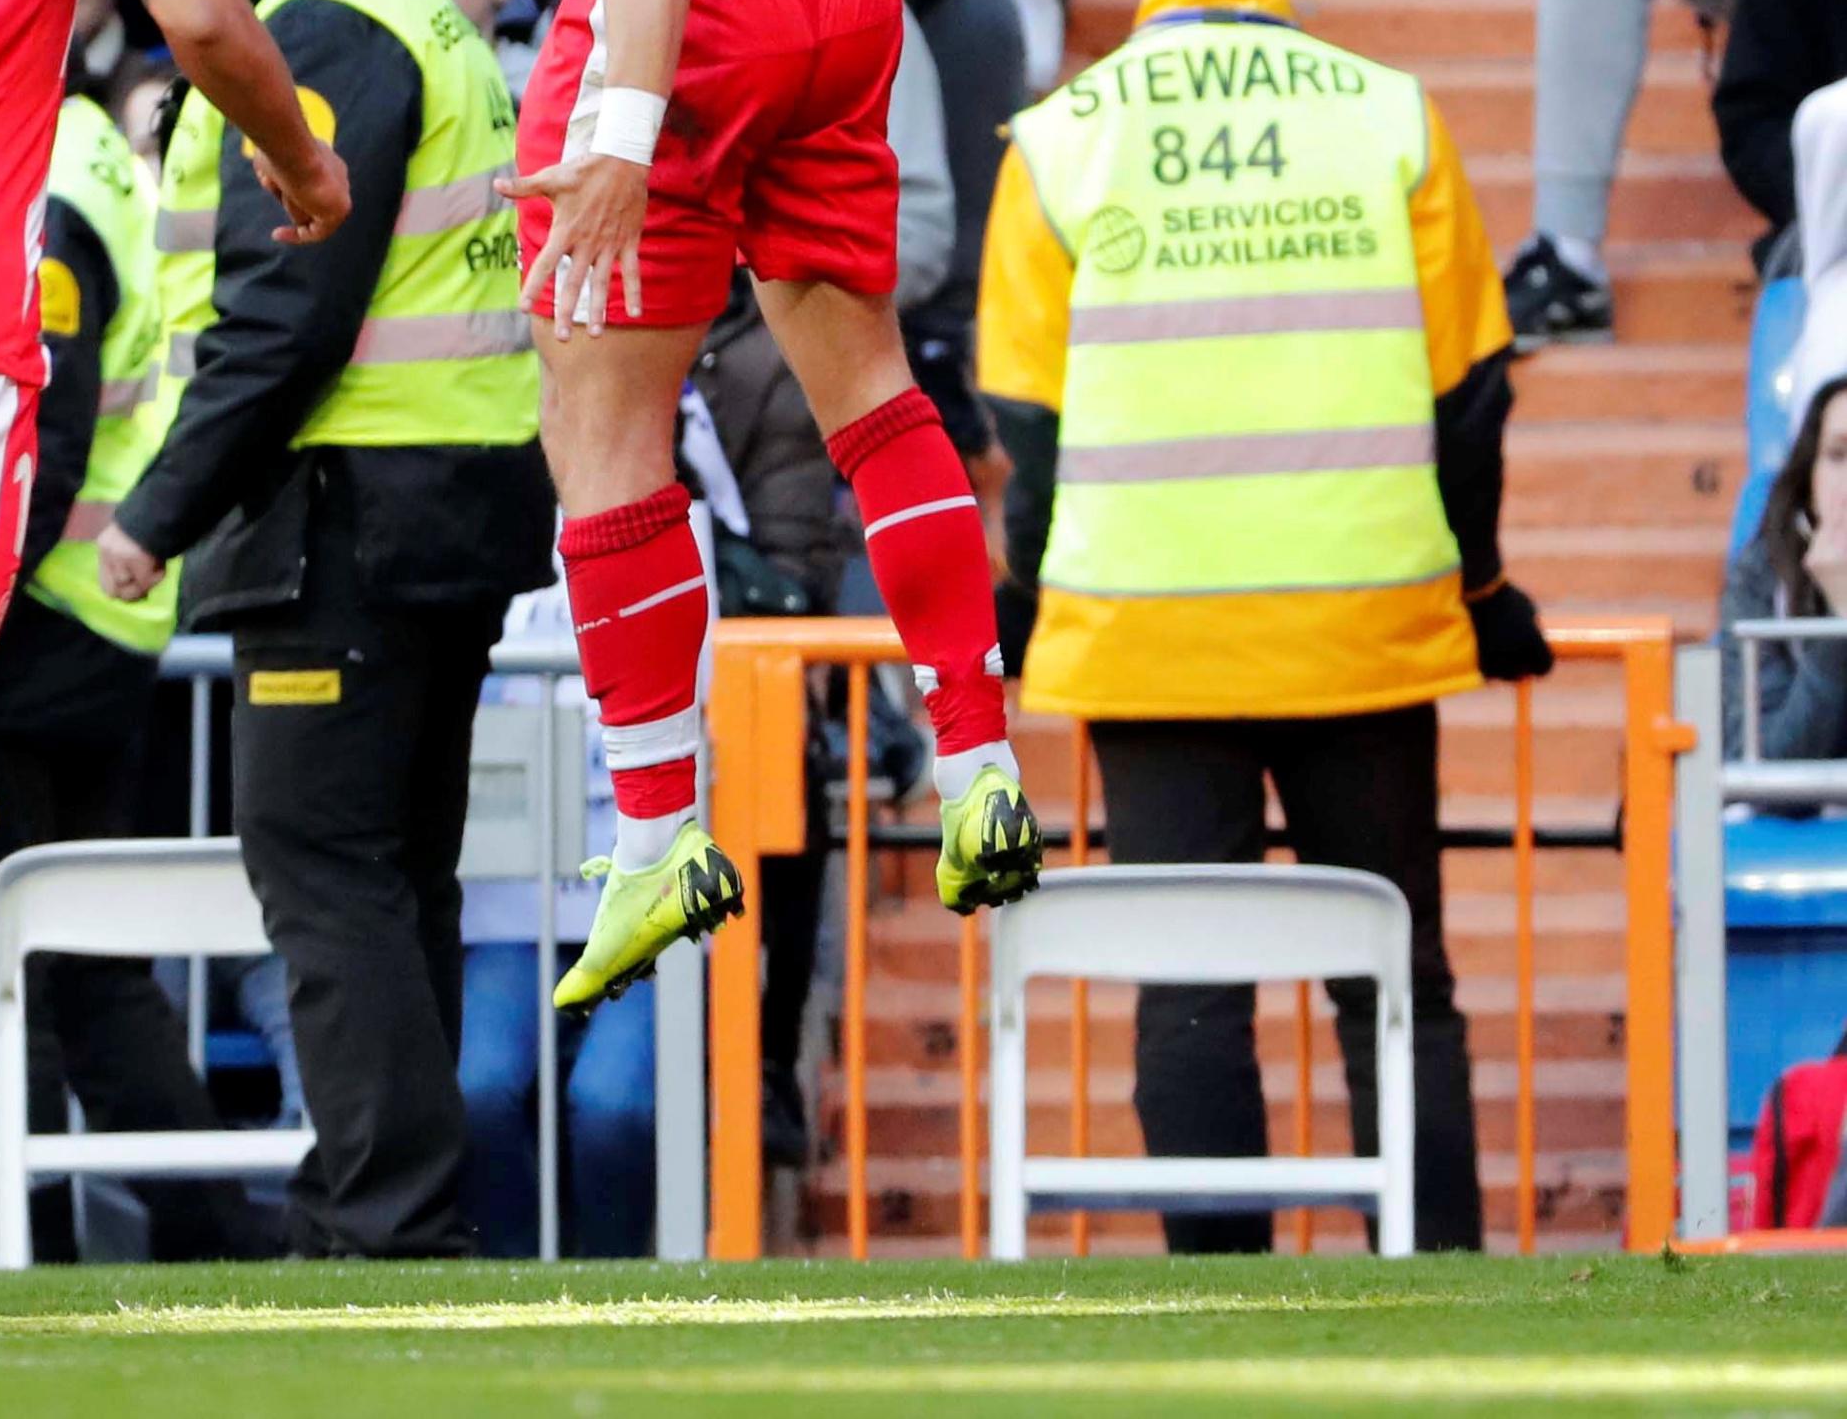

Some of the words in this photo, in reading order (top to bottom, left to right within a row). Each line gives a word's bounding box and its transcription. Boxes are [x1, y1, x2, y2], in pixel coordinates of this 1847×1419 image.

[1068, 45, 1367, 118] STEWARD
[1152, 121, 1287, 186] 844
[1163, 194, 1366, 233] SERVICIOS
[1155, 229, 1380, 269] AUXILIARES
